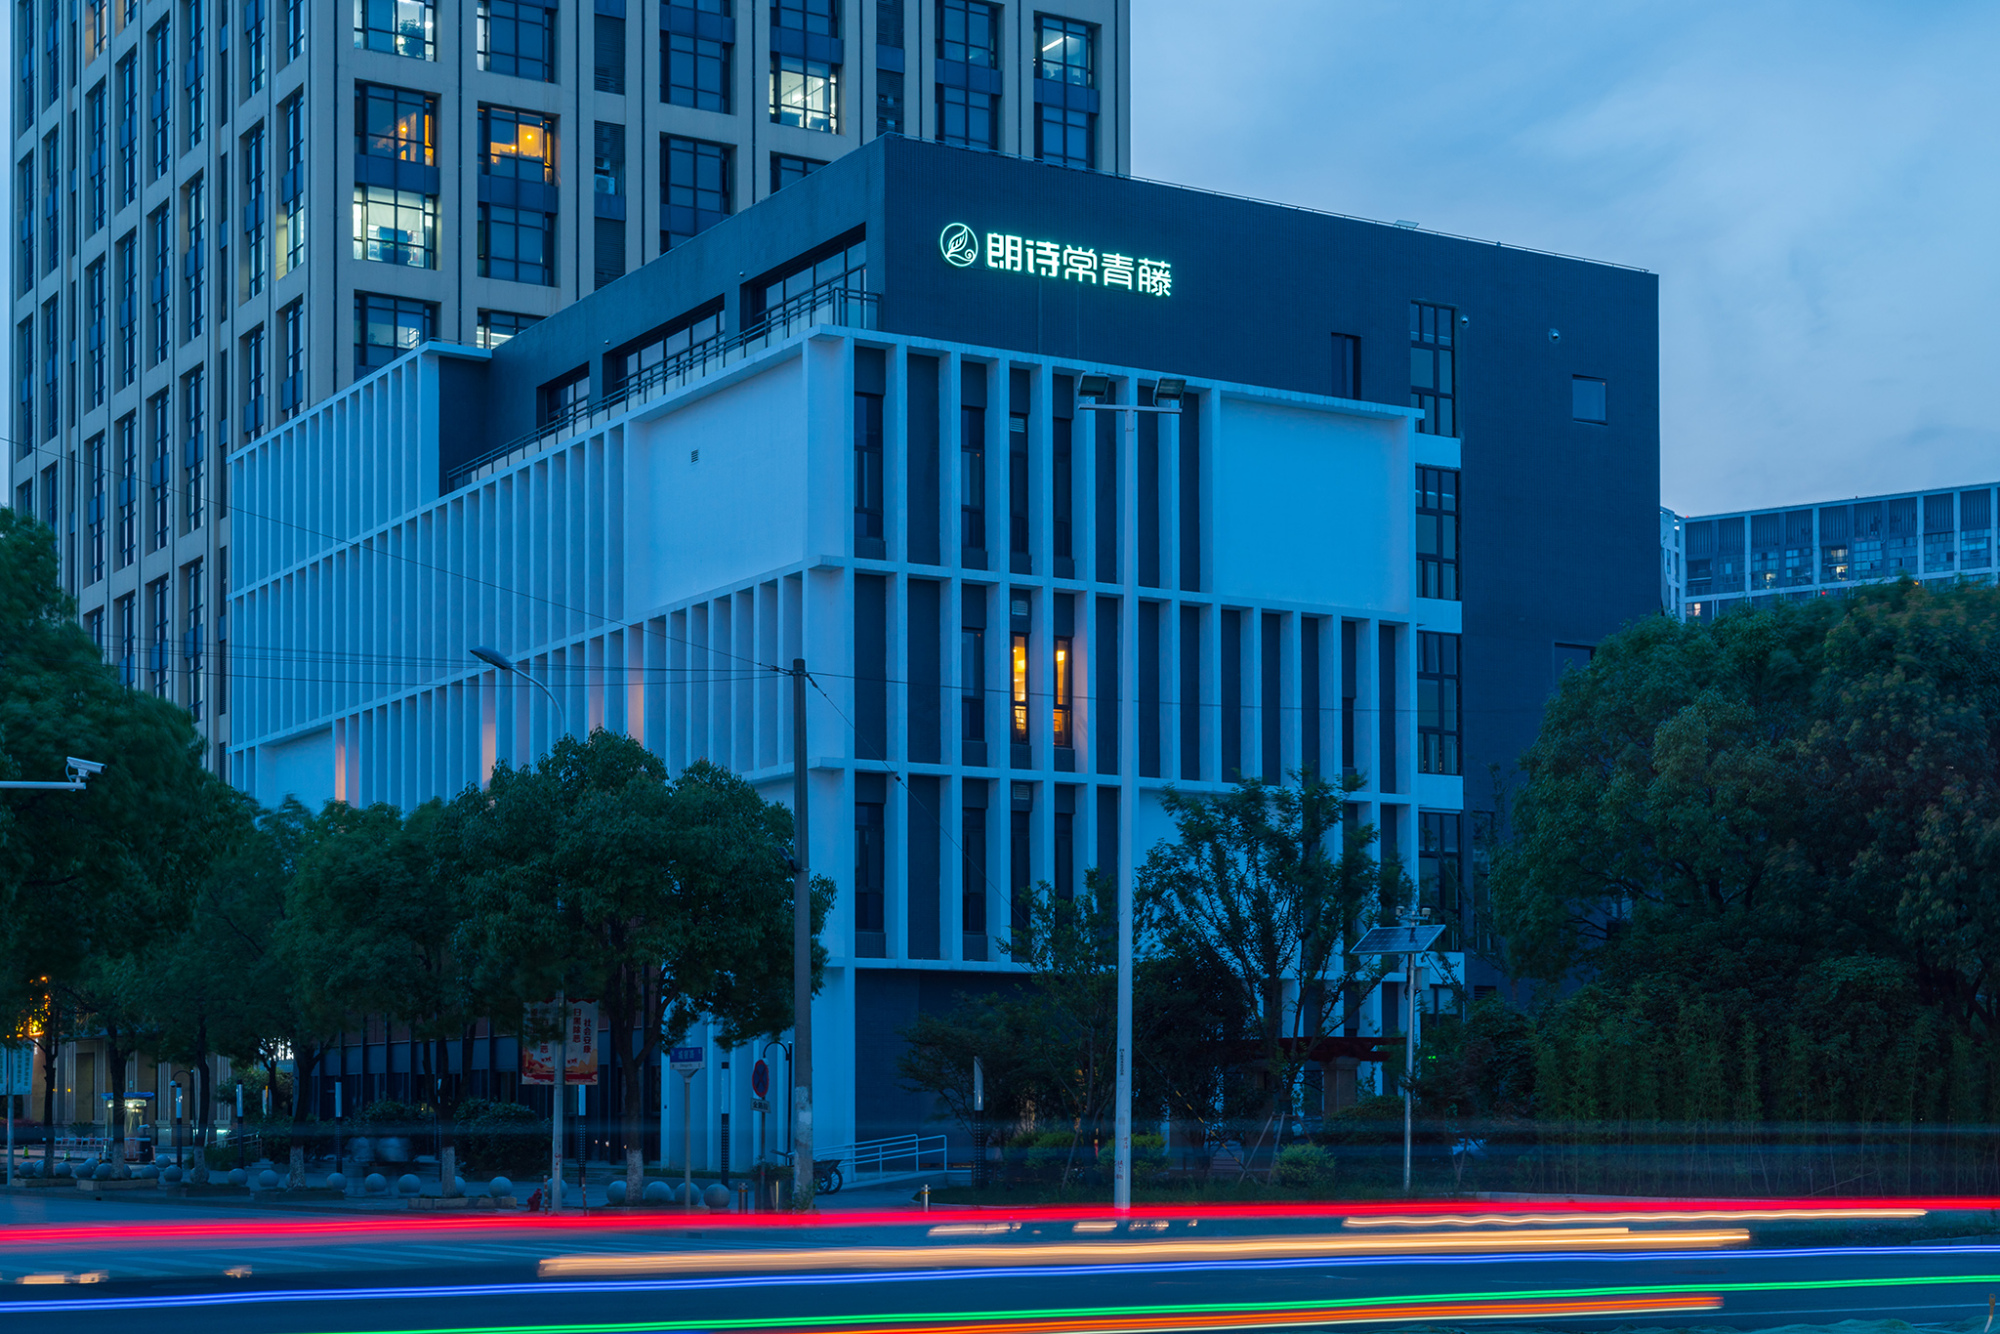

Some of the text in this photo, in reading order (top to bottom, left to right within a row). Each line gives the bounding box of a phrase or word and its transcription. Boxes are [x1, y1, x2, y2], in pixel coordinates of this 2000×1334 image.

[986, 232, 1172, 297] 朗诗常青藤
